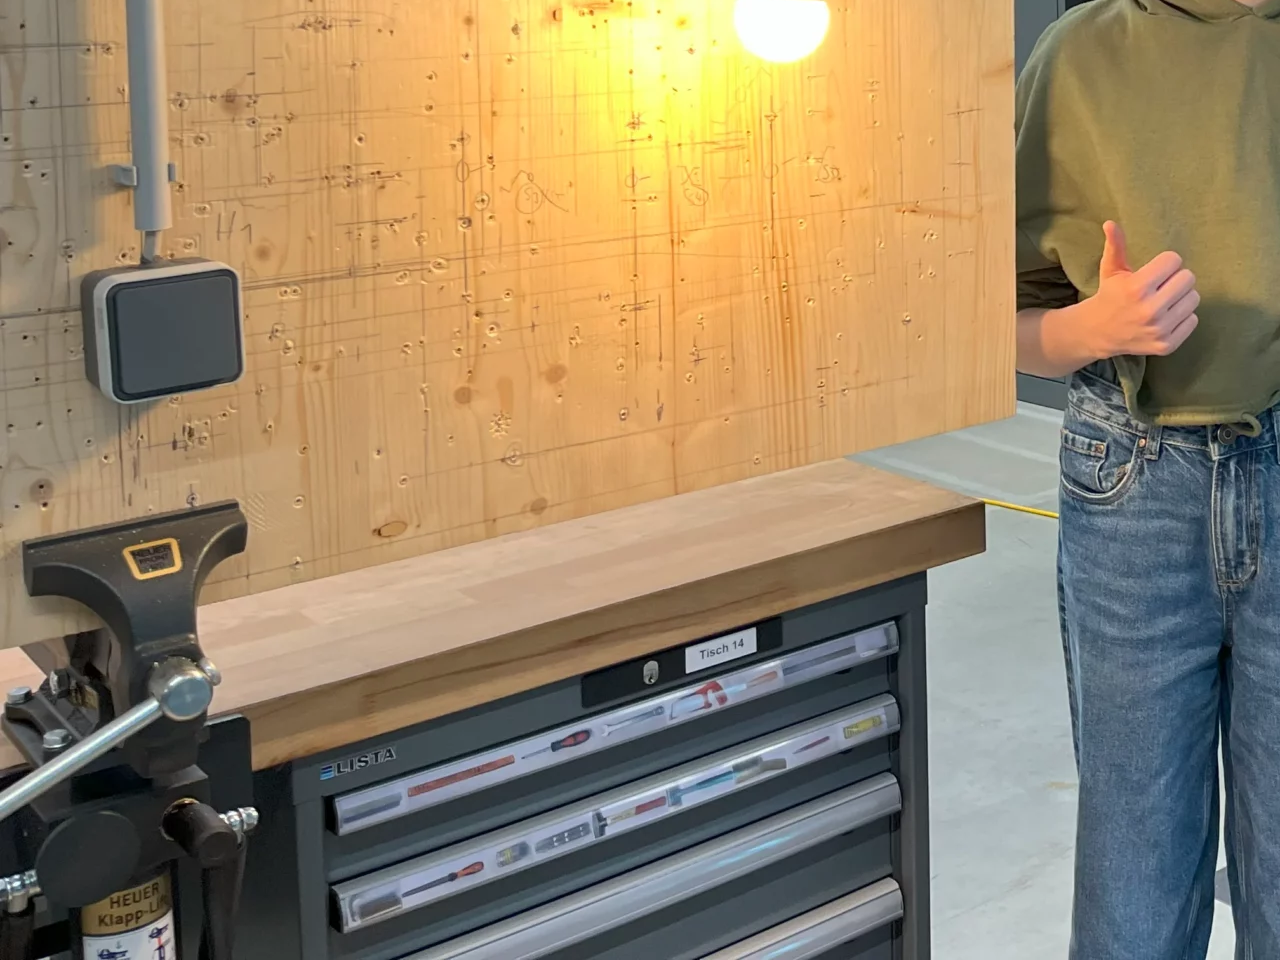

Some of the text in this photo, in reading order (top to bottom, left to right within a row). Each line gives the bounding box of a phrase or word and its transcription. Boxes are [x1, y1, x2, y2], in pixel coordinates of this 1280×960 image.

[700, 638, 745, 660] Tisch 14
[335, 746, 397, 776] LISTA
[110, 882, 160, 909] HEUER
